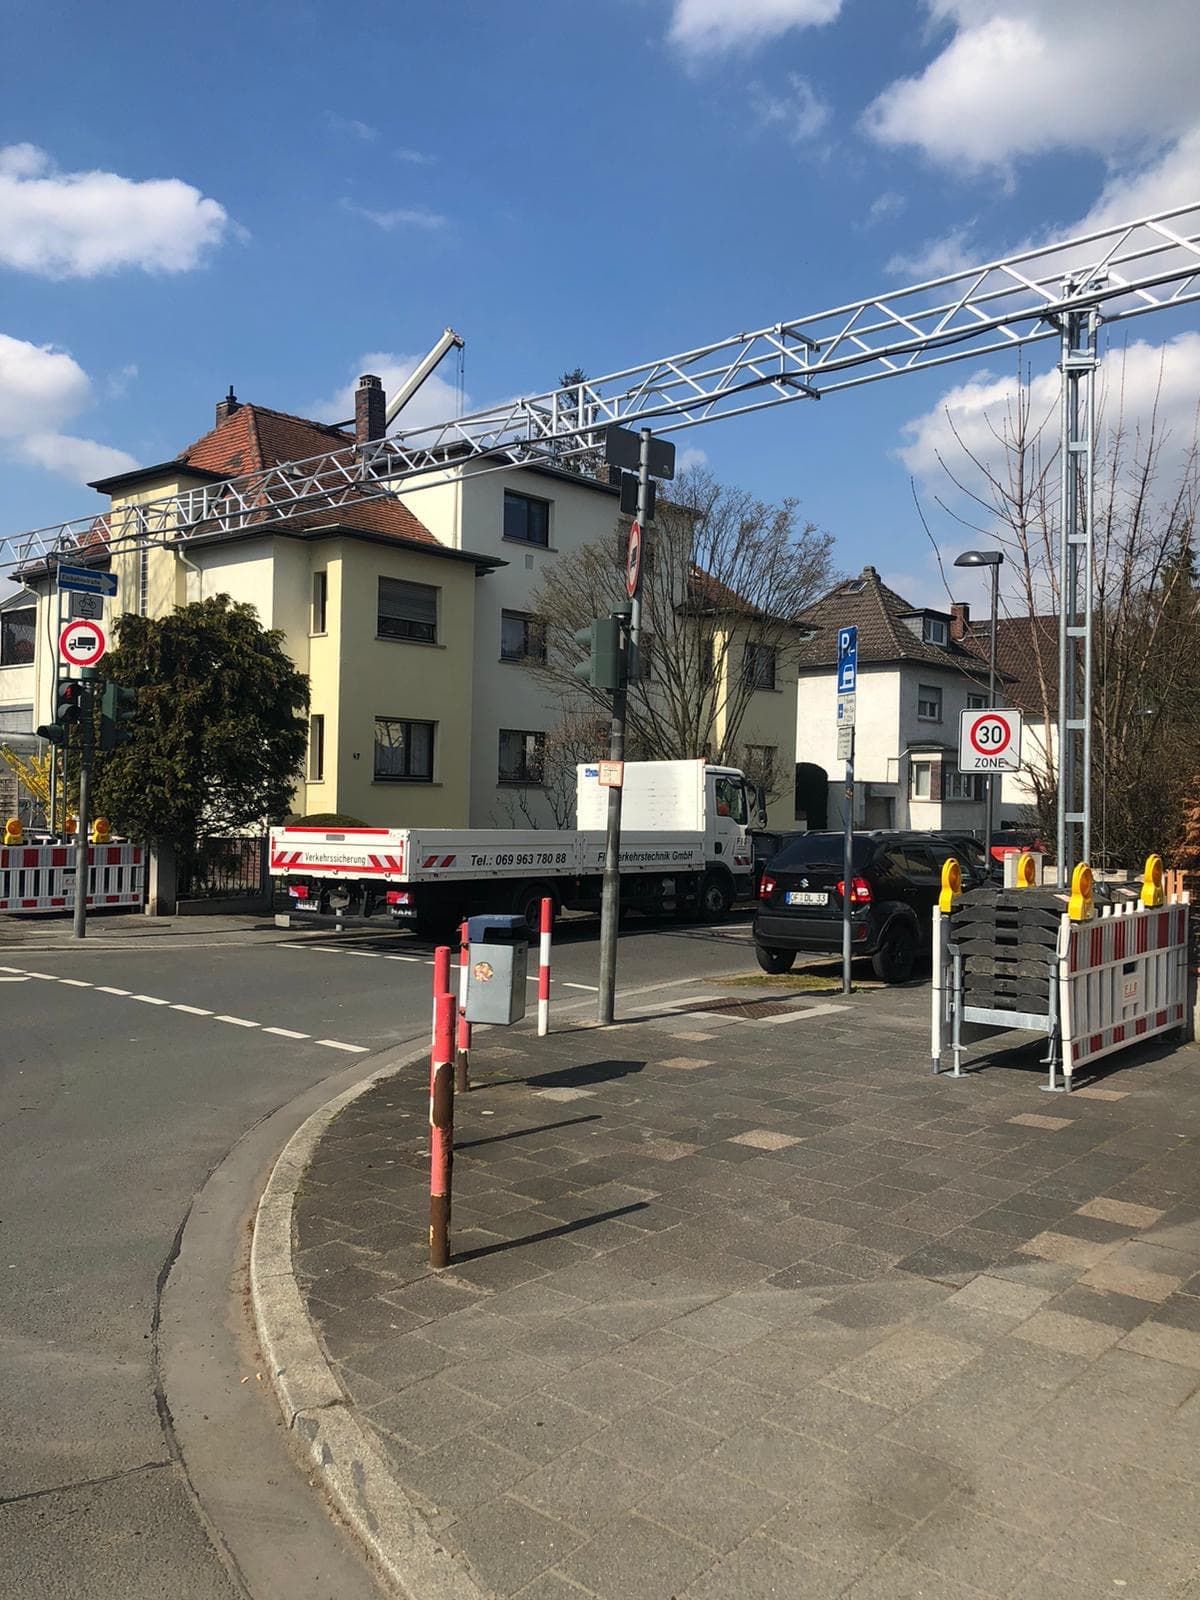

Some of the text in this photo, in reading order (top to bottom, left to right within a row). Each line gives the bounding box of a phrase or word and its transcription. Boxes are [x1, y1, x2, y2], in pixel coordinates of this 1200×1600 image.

[979, 725, 1002, 744] 30
[974, 757, 1006, 768] ZONE
[304, 852, 366, 866] Verkehrssicherung
[471, 852, 567, 866] Tel.: 069 963 780 88
[617, 851, 671, 862] erkehrstechnik
[672, 850, 693, 861] GmbH
